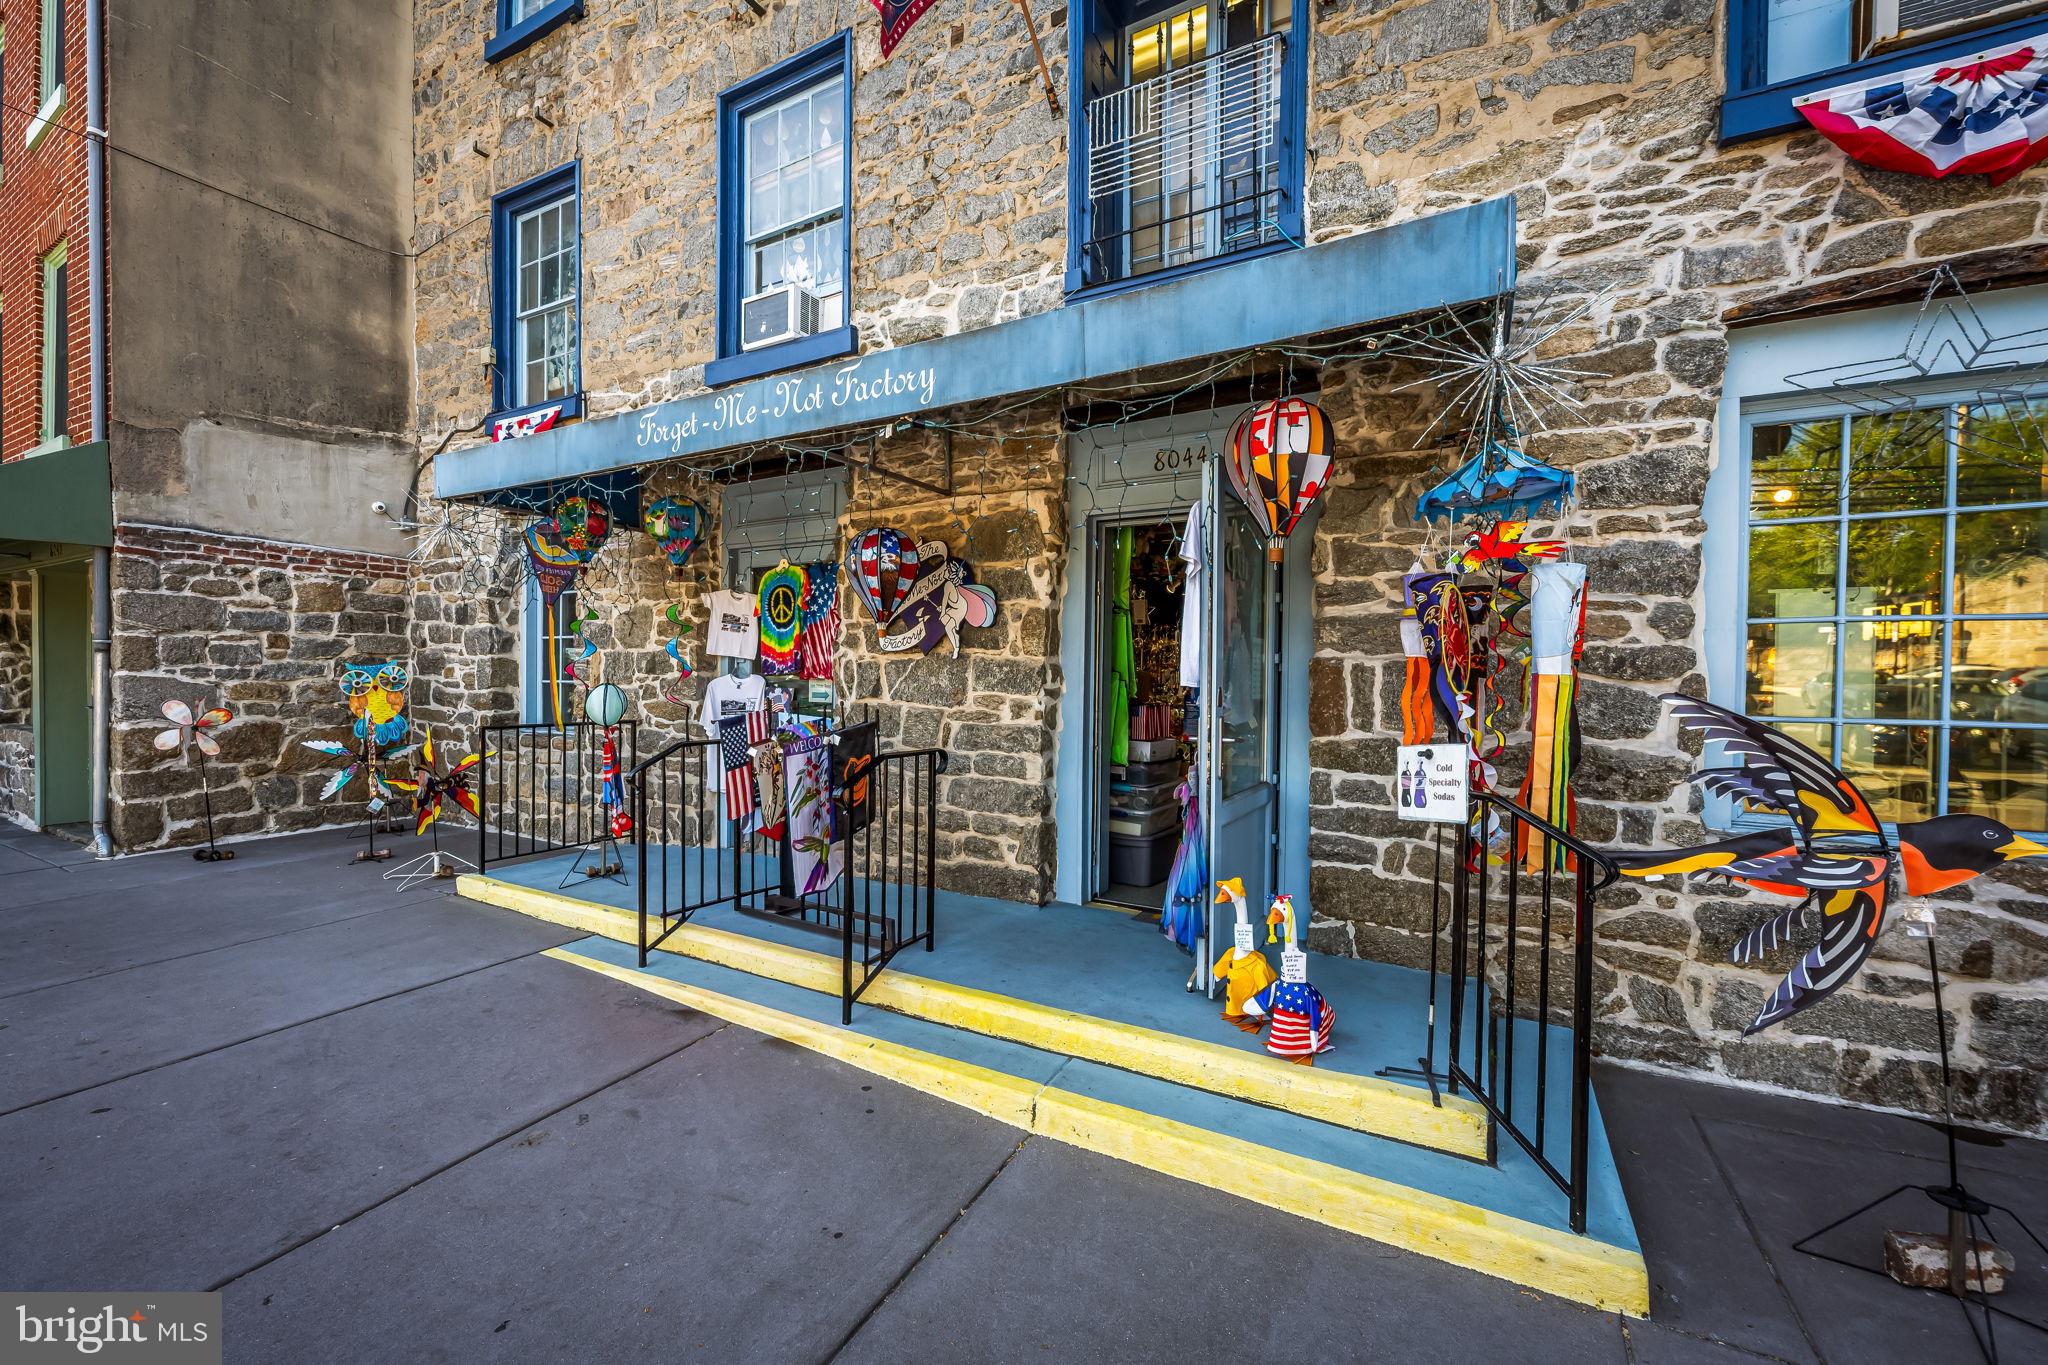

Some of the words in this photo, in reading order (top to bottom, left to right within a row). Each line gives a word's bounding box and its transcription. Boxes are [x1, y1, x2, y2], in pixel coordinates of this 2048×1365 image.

[831, 358, 936, 405] Factory
[1154, 446, 1206, 471] 8044
[920, 544, 940, 558] The
[882, 627, 923, 649] Factory
[789, 736, 824, 754] WELCO
[1436, 764, 1453, 772] Cold
[1428, 778, 1462, 788] Specialty
[1433, 792, 1456, 801] Sodas
